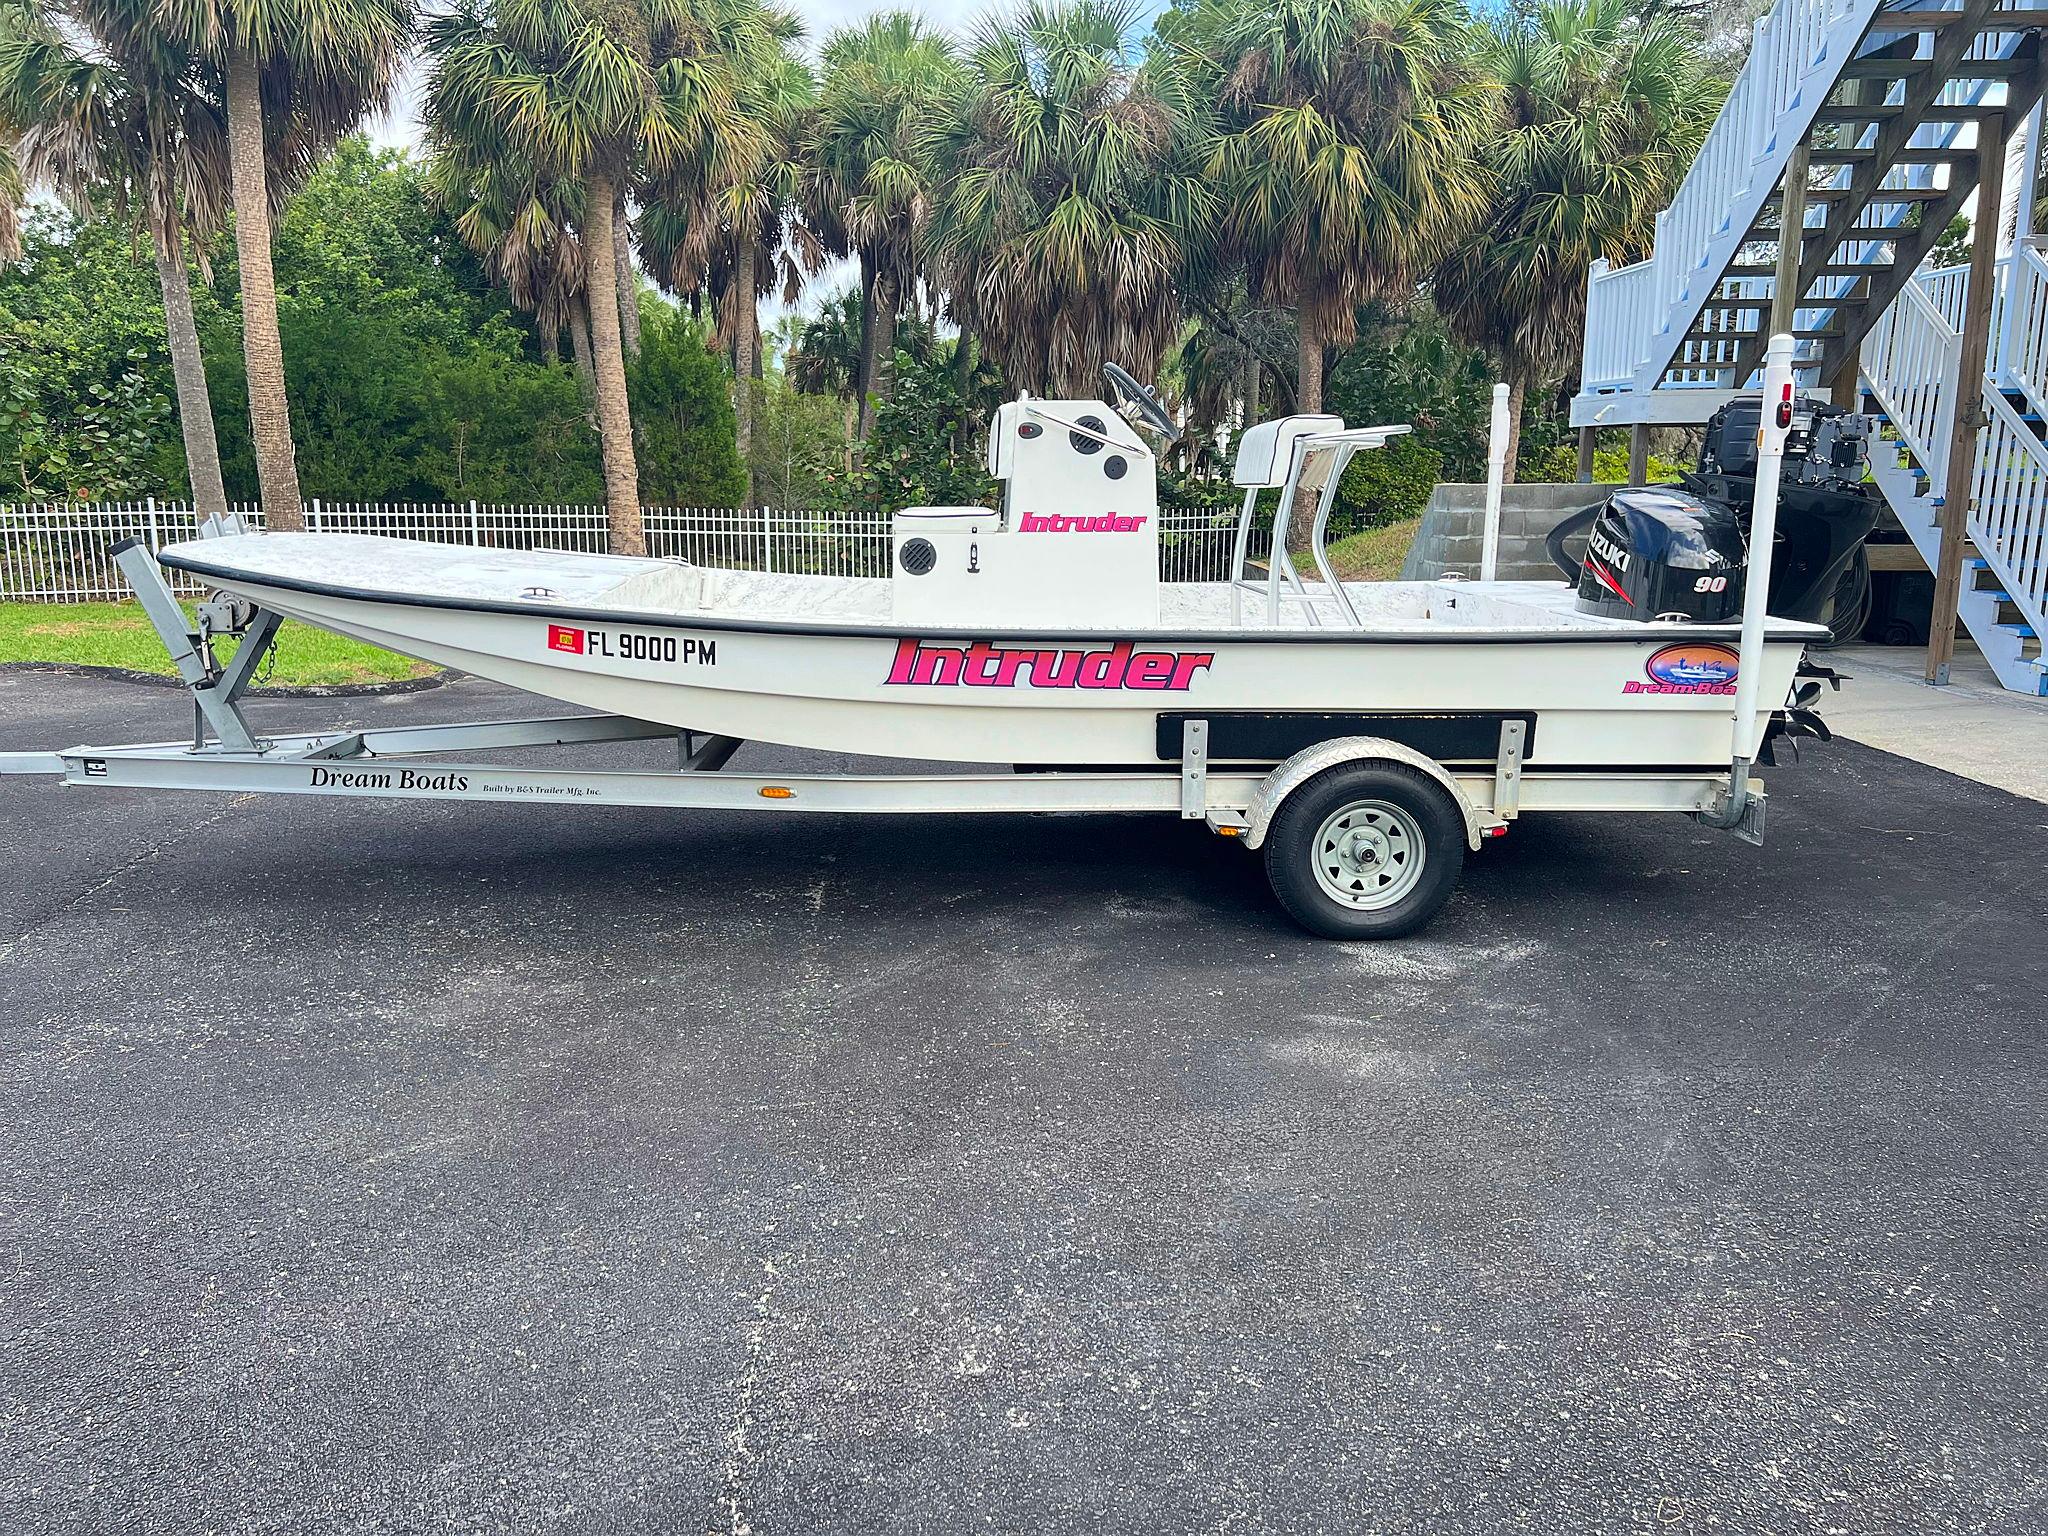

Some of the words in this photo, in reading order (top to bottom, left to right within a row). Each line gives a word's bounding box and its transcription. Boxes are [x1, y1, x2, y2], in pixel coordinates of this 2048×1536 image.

[1018, 511, 1148, 533] Intruder
[1589, 527, 1631, 573] UZUKI
[1693, 576, 1728, 593] 90
[587, 631, 614, 657] FL
[619, 633, 677, 662] 9000
[683, 638, 716, 666] PM
[883, 638, 1215, 691] Intruder
[310, 767, 392, 789] Dream
[398, 769, 469, 792] Boats
[482, 784, 503, 793] Built
[504, 785, 515, 795] by
[516, 785, 534, 794] B&S
[535, 786, 564, 795] Trailer
[566, 787, 584, 796] Mfg.
[586, 788, 602, 796] Inc.
